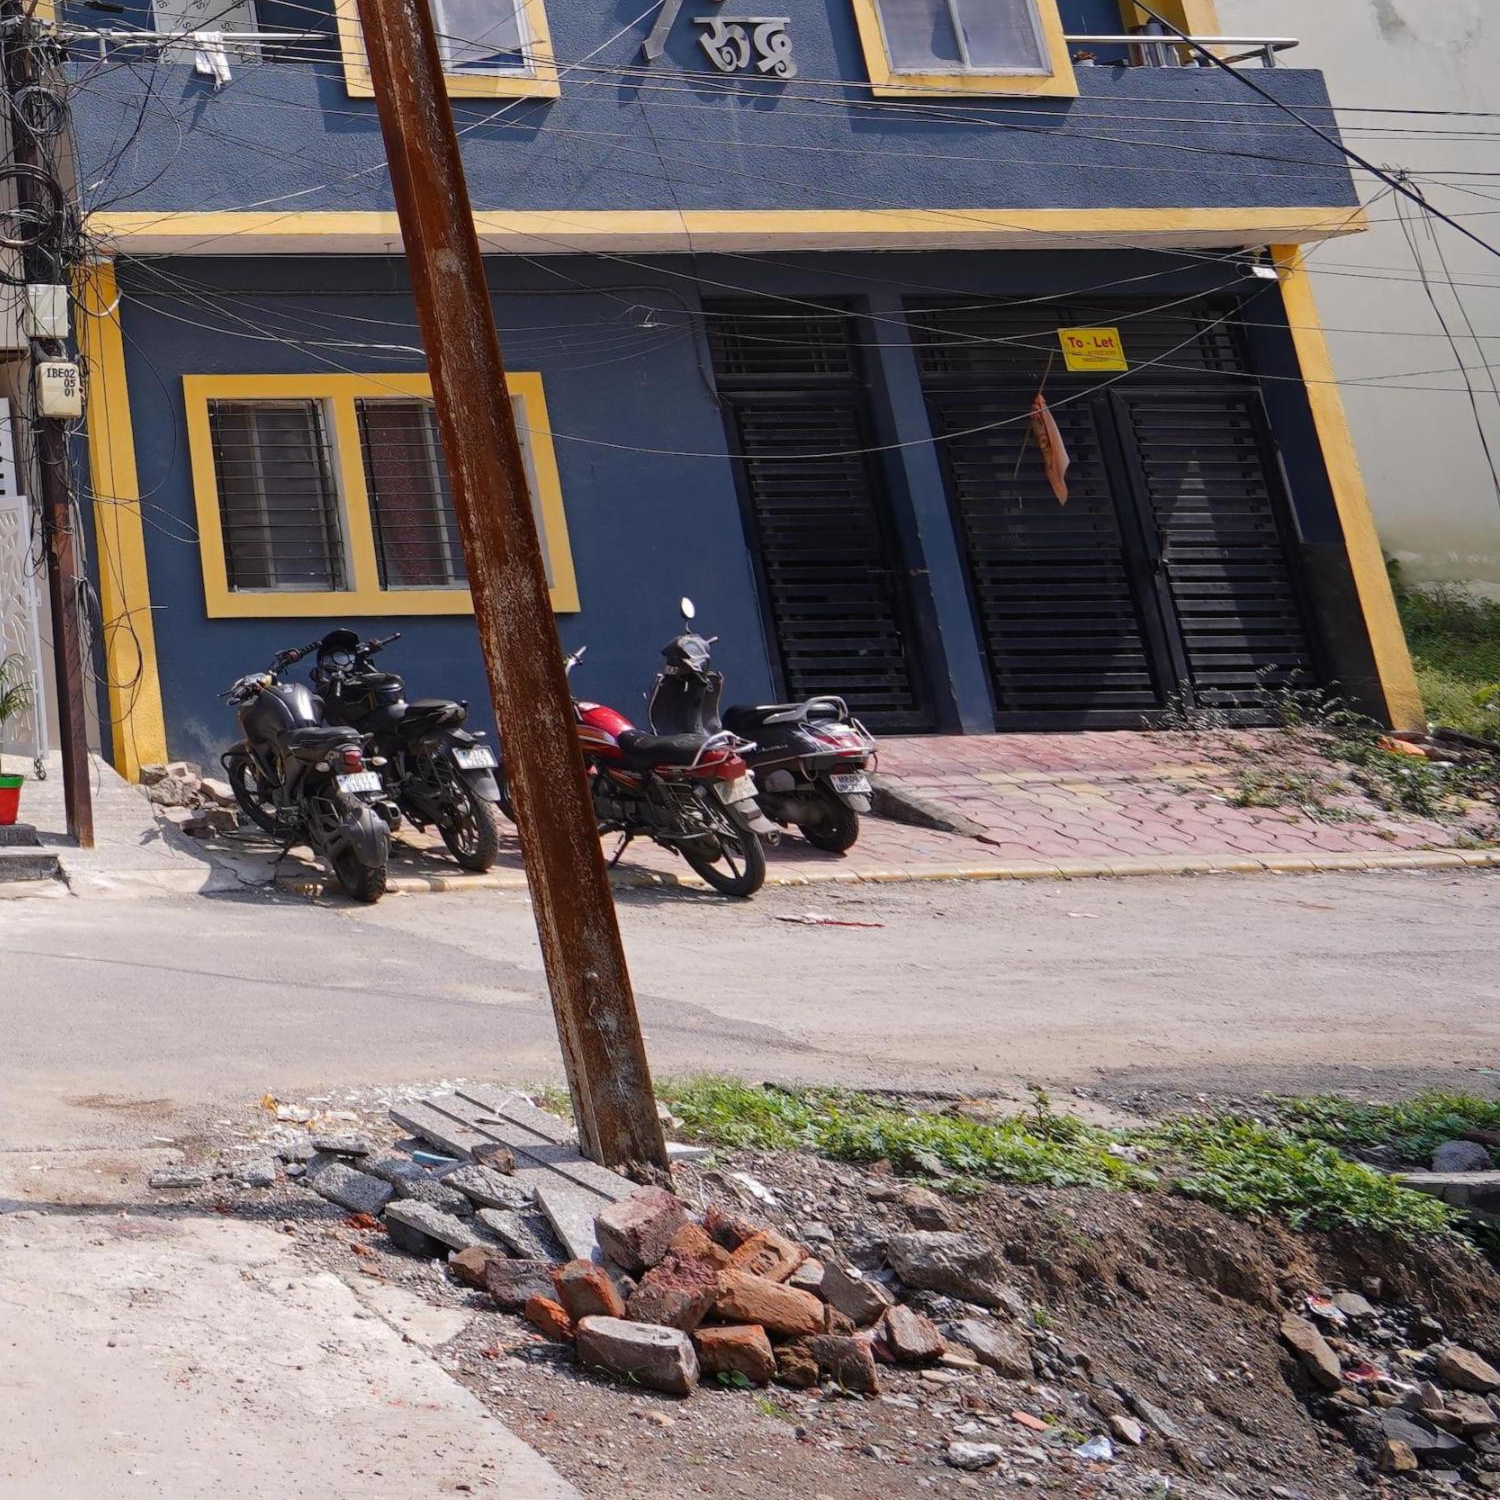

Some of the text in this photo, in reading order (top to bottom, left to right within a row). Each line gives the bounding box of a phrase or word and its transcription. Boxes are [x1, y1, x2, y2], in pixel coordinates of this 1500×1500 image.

[1067, 337, 1083, 348] To
[1093, 336, 1114, 348] Let
[64, 379, 76, 387] 05
[64, 388, 75, 397] 01
